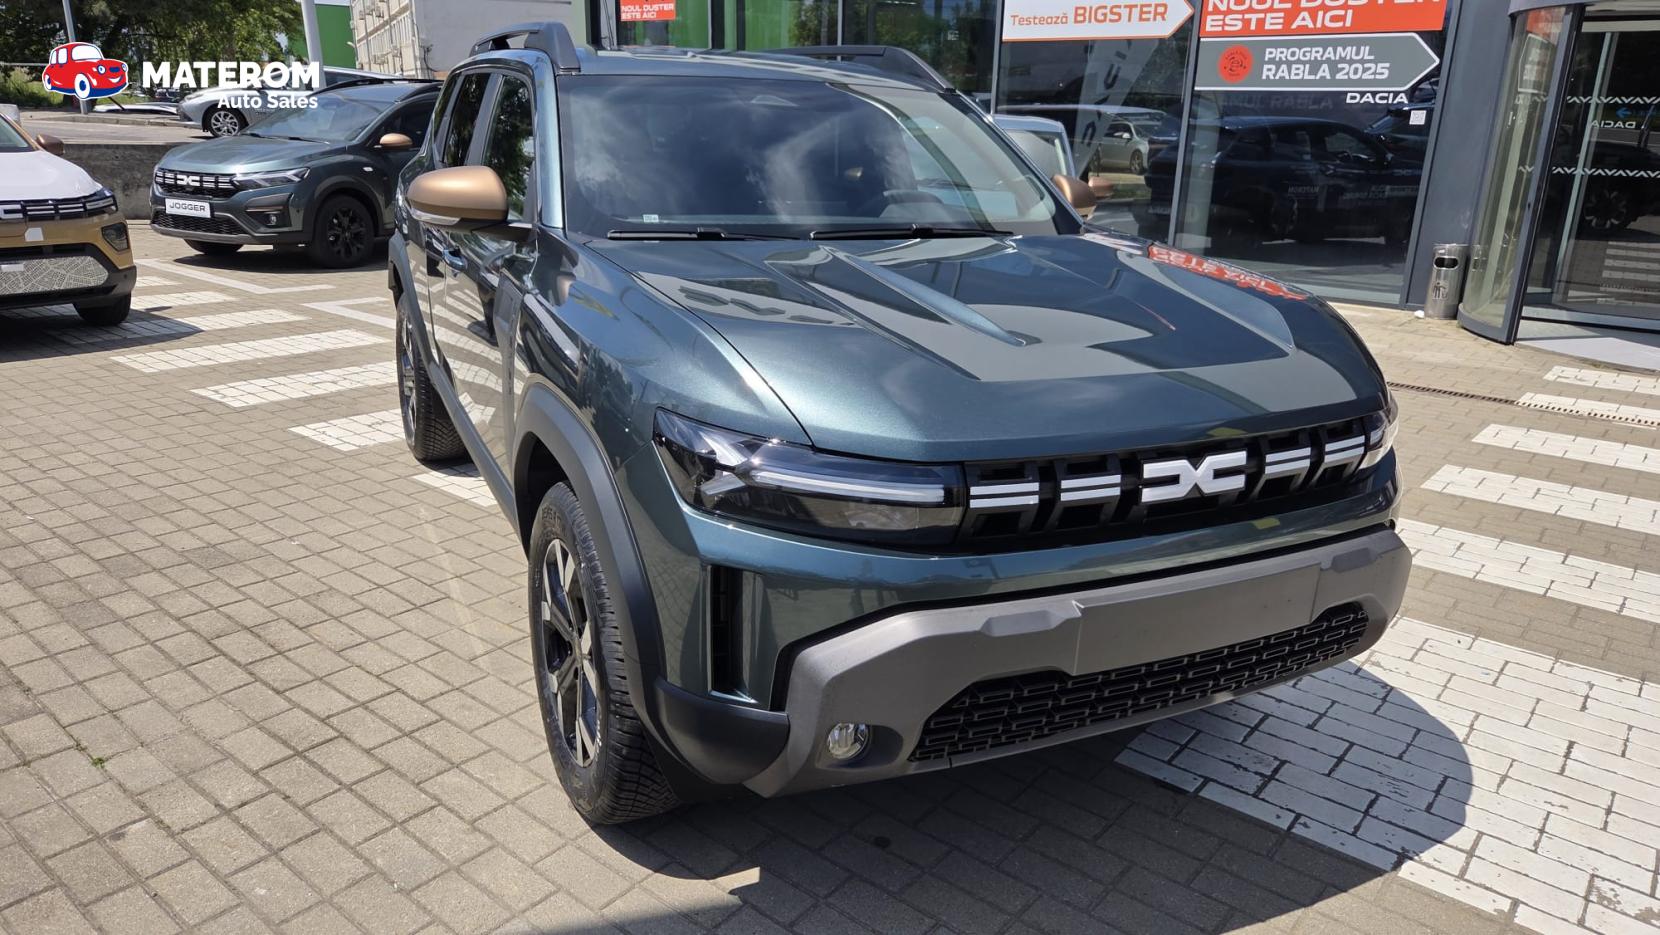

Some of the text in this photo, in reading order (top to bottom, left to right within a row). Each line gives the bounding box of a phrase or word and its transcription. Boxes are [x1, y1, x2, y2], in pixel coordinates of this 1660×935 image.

[1010, 3, 1168, 26] Testează BIGSTER
[1205, 9, 1354, 32] ESTE AICI
[1264, 46, 1376, 62] PROGRAMUL
[1261, 63, 1391, 80] RABLA 2025
[1345, 92, 1409, 105] DACIA
[169, 202, 206, 211] JOGGER
